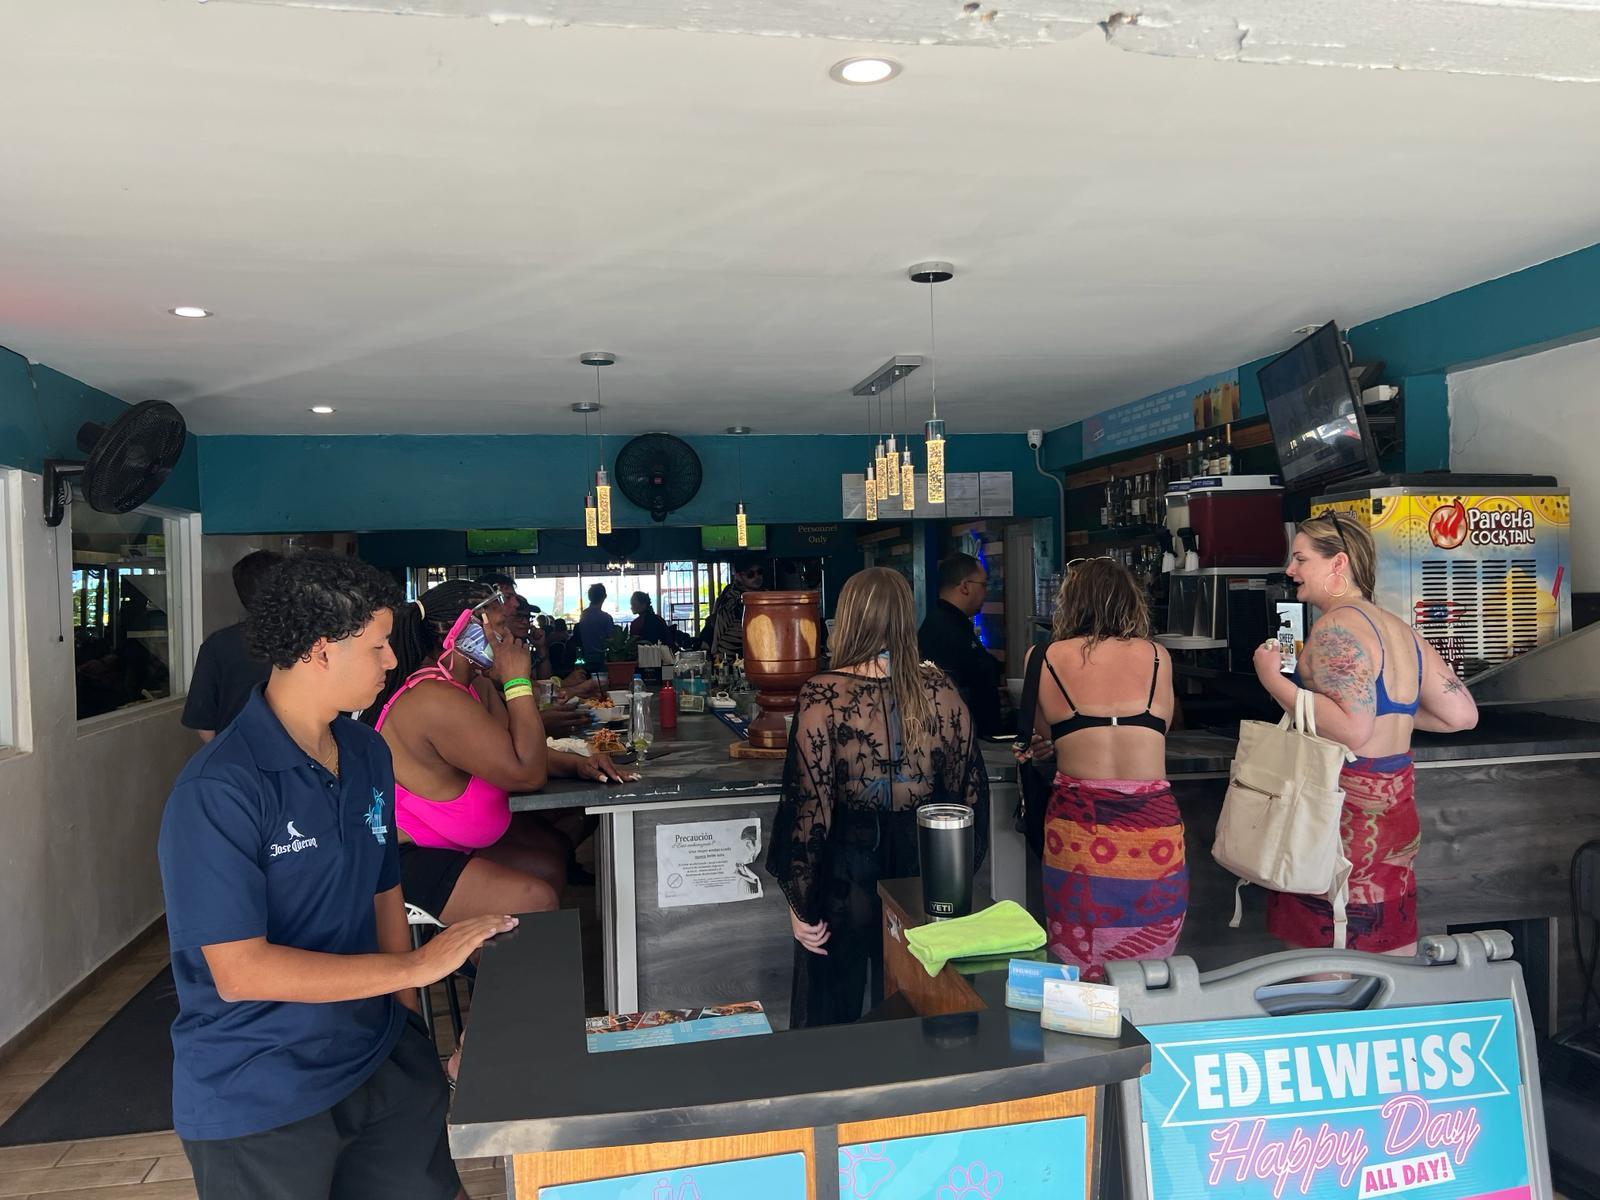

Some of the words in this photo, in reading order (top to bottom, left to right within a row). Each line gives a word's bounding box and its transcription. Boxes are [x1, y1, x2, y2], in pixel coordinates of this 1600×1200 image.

[808, 535, 827, 544] Only
[1471, 530, 1535, 544] COCKTAIL
[675, 832, 712, 842] Precaución
[291, 837, 318, 852] Cuervo
[931, 904, 951, 912] YETI
[1194, 1032, 1476, 1110] EDELWEISS
[1209, 1118, 1368, 1199] Happy
[1381, 1095, 1480, 1164] Day
[1365, 1166, 1398, 1192] ALL
[1402, 1157, 1449, 1186] DAY!
